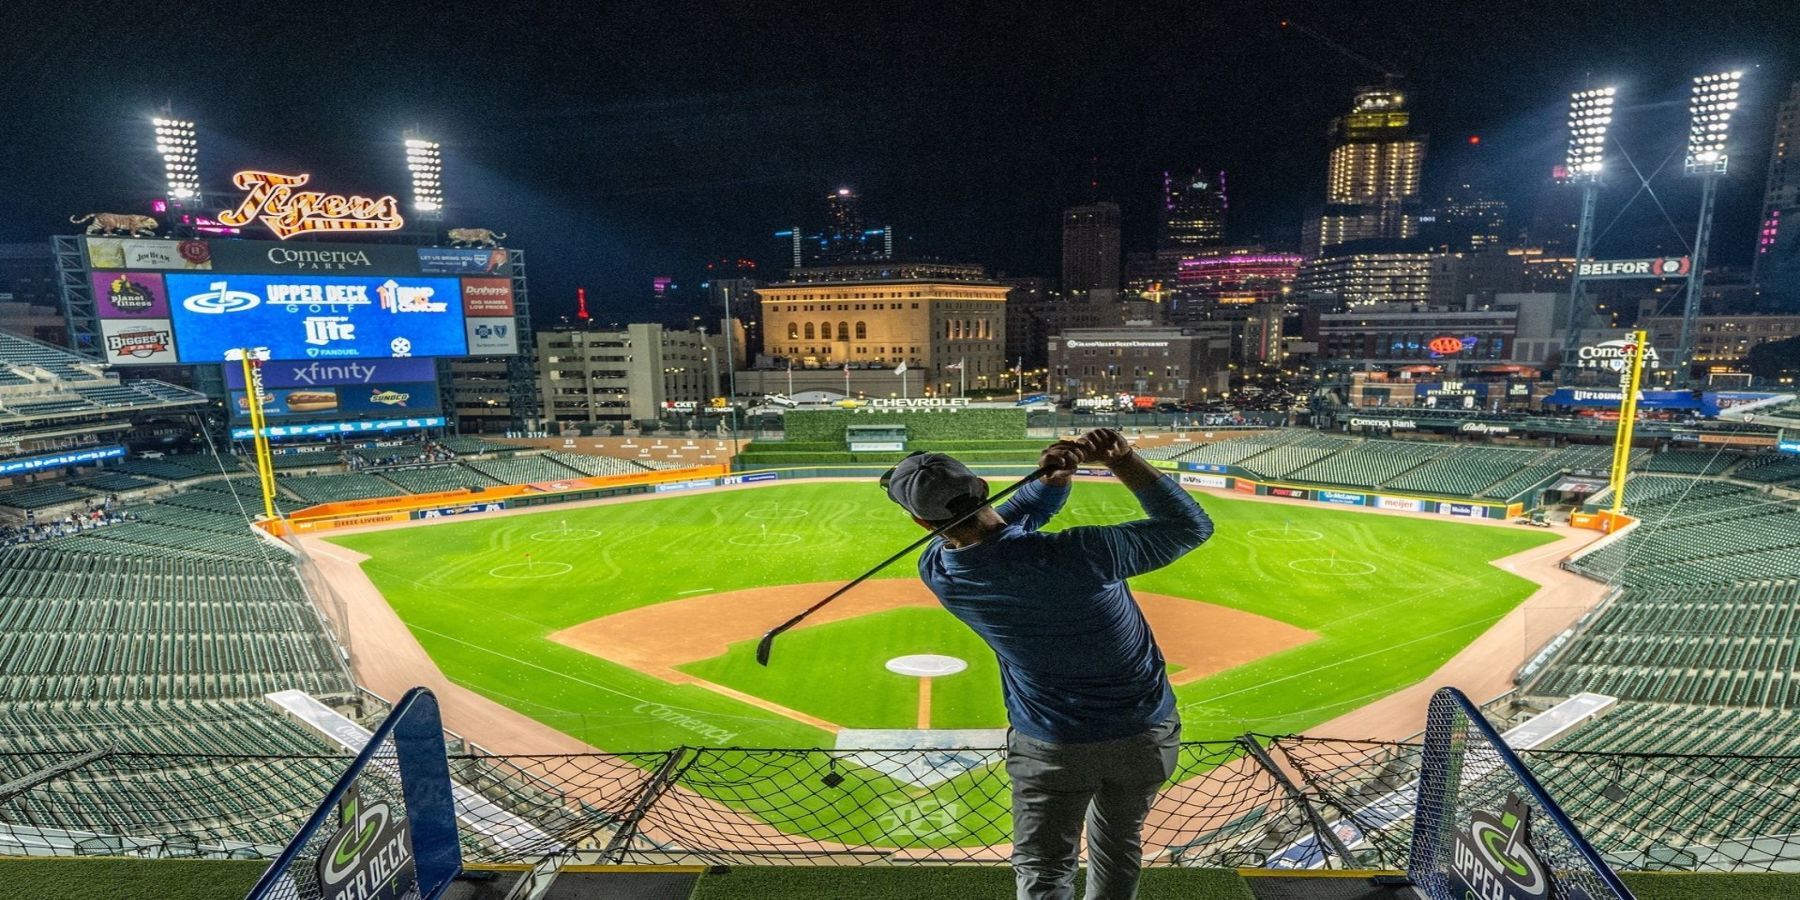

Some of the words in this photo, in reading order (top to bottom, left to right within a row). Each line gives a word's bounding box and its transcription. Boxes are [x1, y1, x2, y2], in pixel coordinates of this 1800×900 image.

[217, 170, 404, 240] Tigers
[298, 262, 346, 270] PARK
[1579, 261, 1650, 275] BELFOR
[111, 294, 145, 303] planet
[265, 284, 323, 301] UPPER
[325, 285, 367, 301] DECK
[117, 299, 152, 307] fitness
[286, 304, 356, 313] GOLF
[302, 318, 356, 345] Lite
[109, 332, 168, 350] BIGGEST
[1432, 339, 1459, 351] AAA
[320, 348, 359, 356] FANDUEL
[293, 362, 376, 384] xfinity
[370, 393, 410, 404] SUNOCO
[873, 398, 972, 407] CHEVROLET
[1076, 396, 1114, 410] meijer
[369, 828, 409, 890] DECK
[1454, 837, 1505, 900] UPPER
